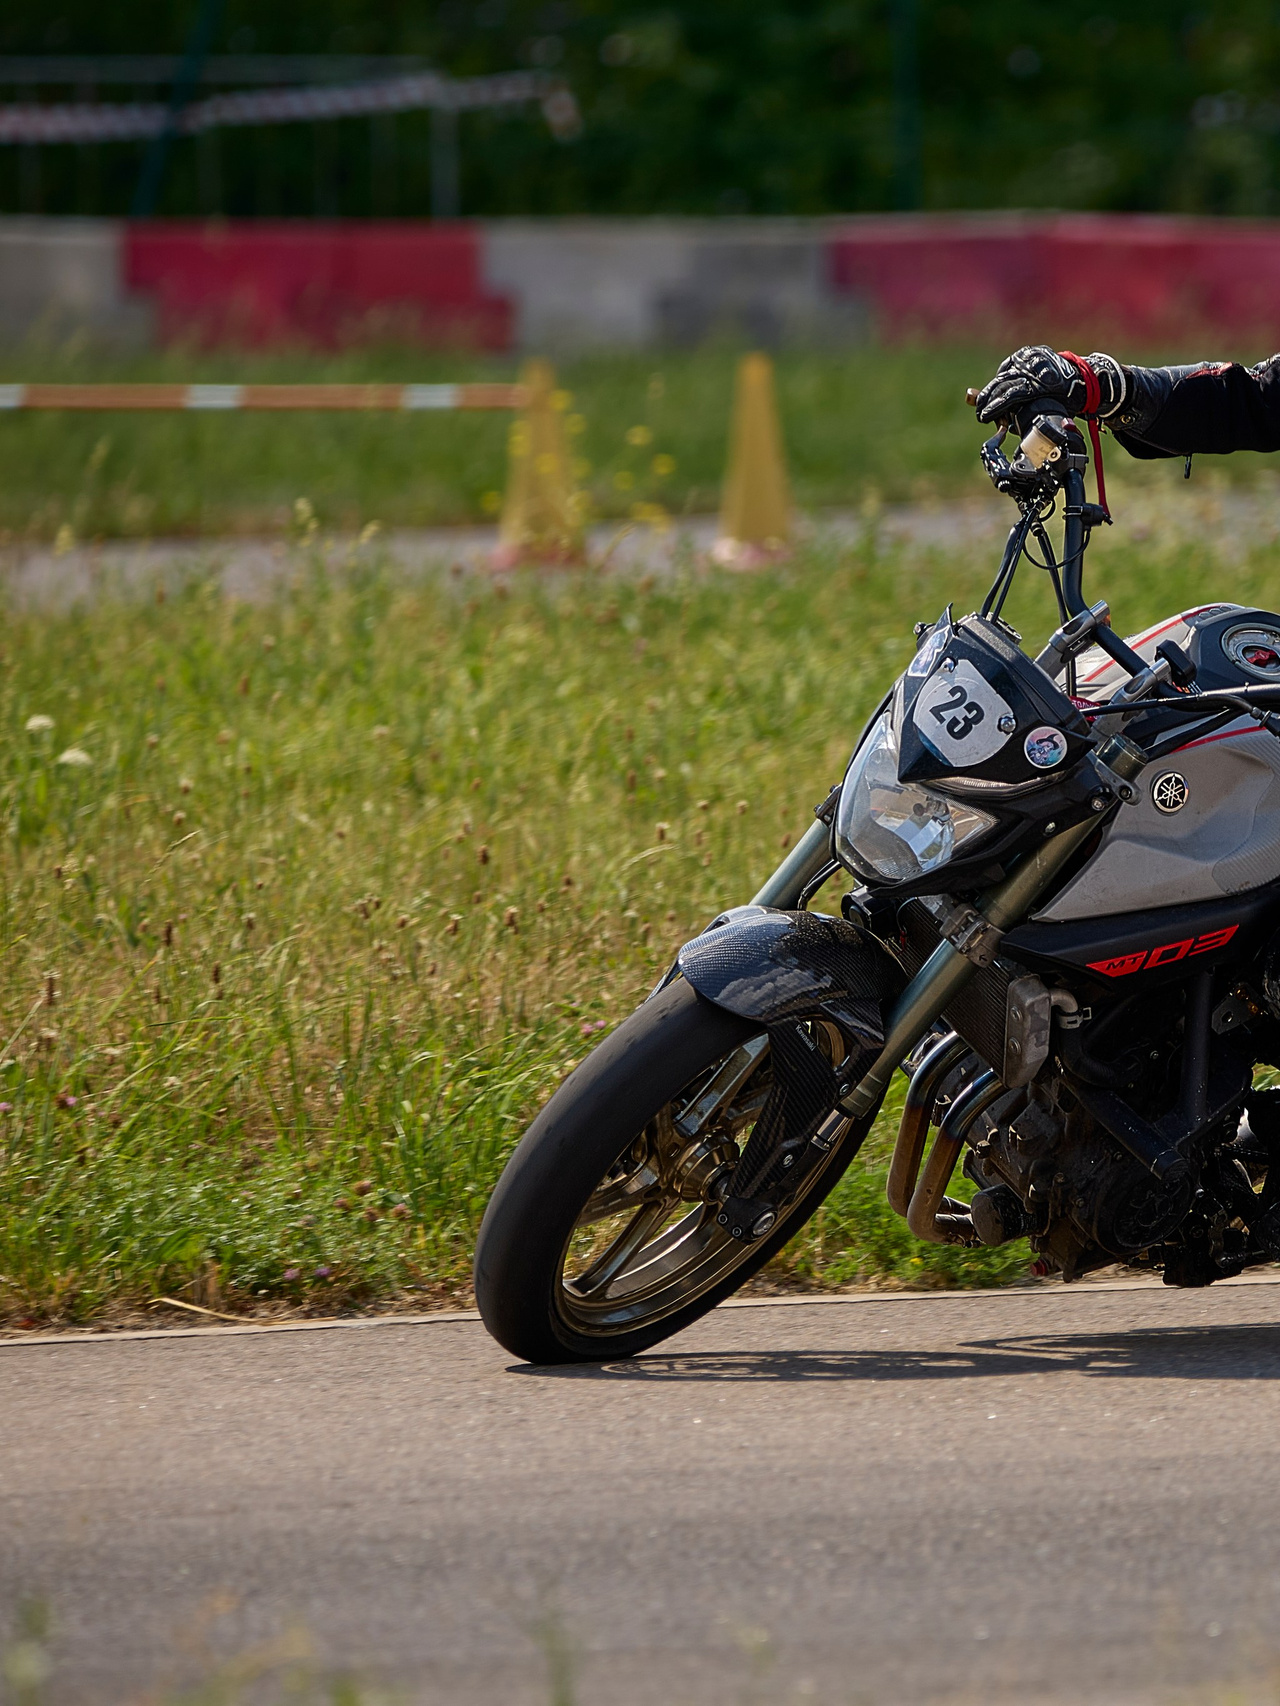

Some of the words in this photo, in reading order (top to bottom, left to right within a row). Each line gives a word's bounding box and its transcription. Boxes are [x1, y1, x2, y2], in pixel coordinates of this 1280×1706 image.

[928, 685, 985, 741] 23
[1105, 952, 1147, 971] MT
[1143, 924, 1240, 970] 03
[795, 1024, 817, 1052] Kawasaki
